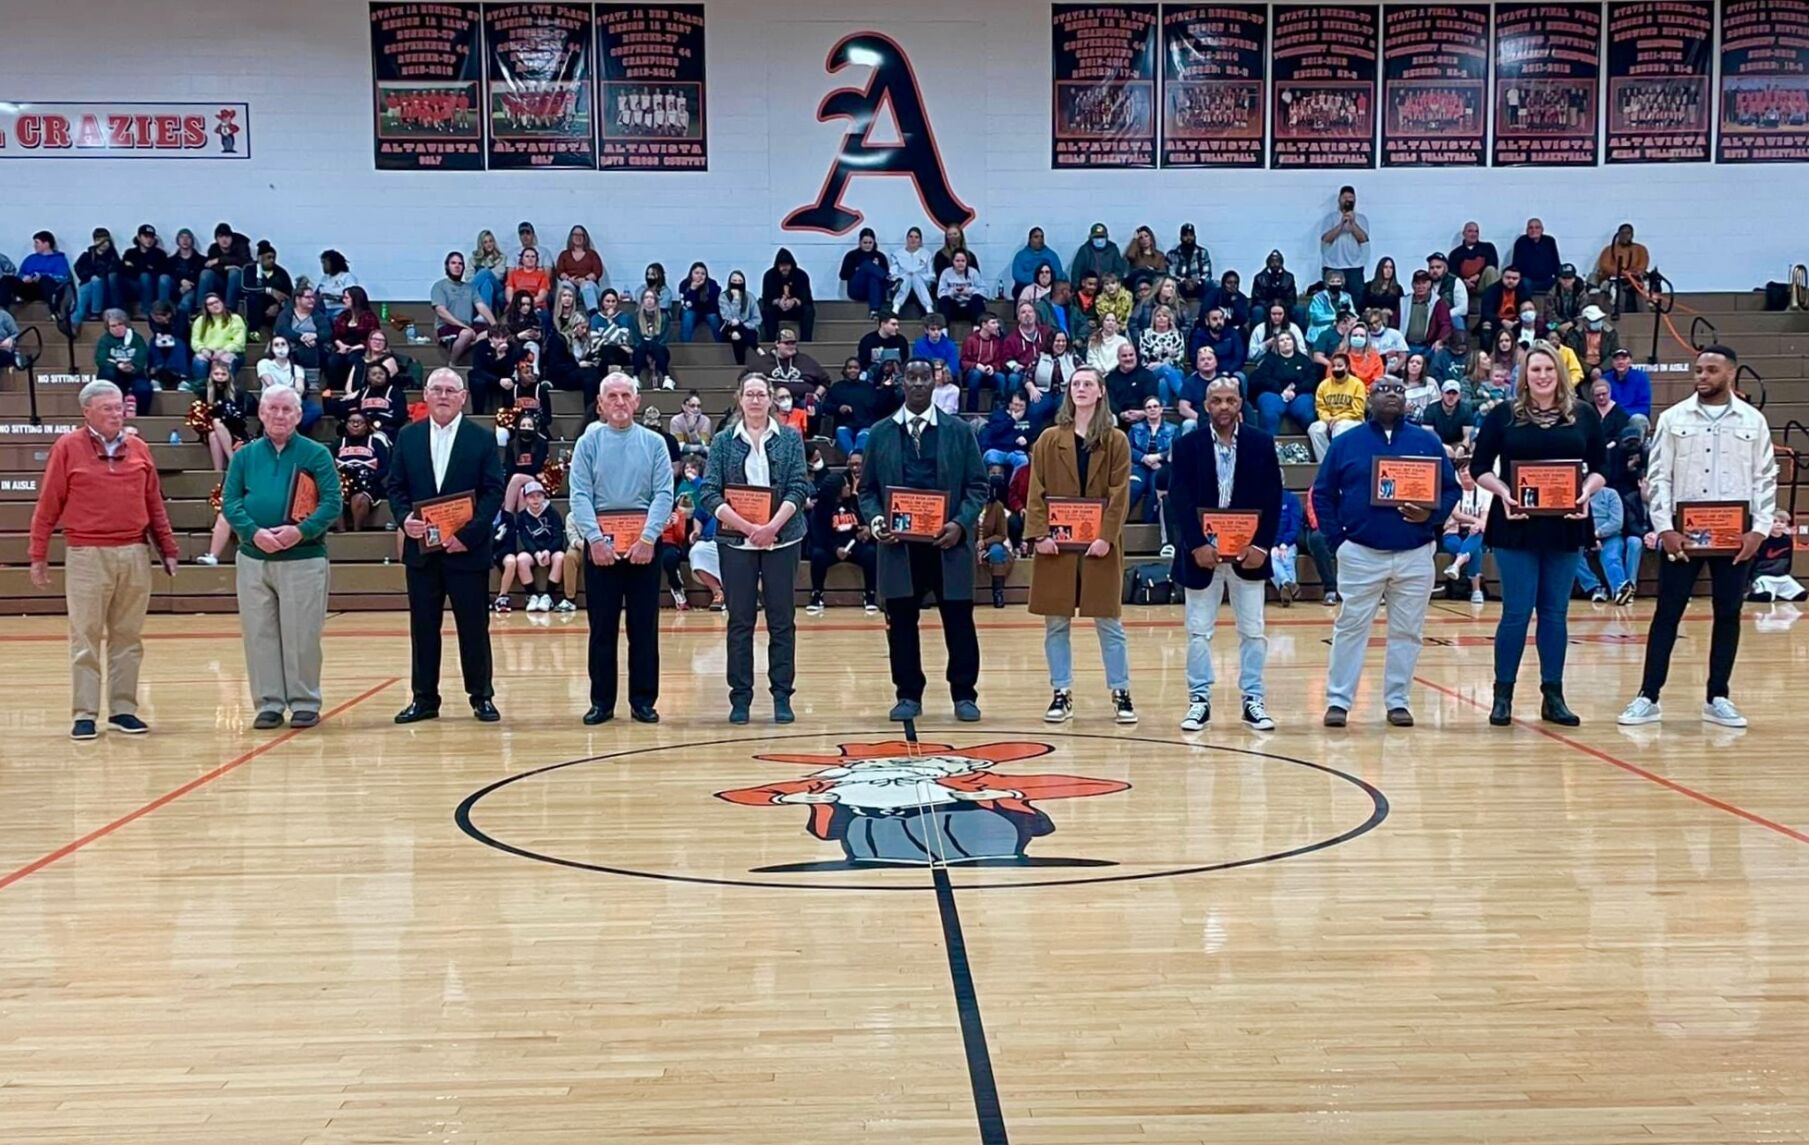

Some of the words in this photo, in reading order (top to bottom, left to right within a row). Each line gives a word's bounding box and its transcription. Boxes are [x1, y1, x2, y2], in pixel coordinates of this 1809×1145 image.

[15, 114, 207, 149] CRAZIES
[782, 30, 975, 236] A
[1165, 141, 1261, 150] ALTAVISTA
[1386, 141, 1481, 150] ALTAVISTA
[1496, 140, 1593, 149] ALTAVISTA
[1609, 136, 1706, 146] ALTAVISTA
[381, 143, 479, 153] ALTAVISTA
[494, 142, 590, 153] ALTAVISTA
[604, 144, 702, 154] ALTAVISTA
[1056, 142, 1152, 151] ALTAVISTA
[1275, 142, 1371, 151] ALTAVISTA
[38, 374, 49, 384] NO
[50, 374, 80, 384] SITTING
[82, 374, 90, 384] IN
[0, 425, 10, 434] NO
[11, 425, 42, 434] SITTING
[44, 425, 53, 434] IN
[54, 424, 77, 434] AISLE
[1, 481, 11, 490] IN
[12, 481, 36, 490] AISLE
